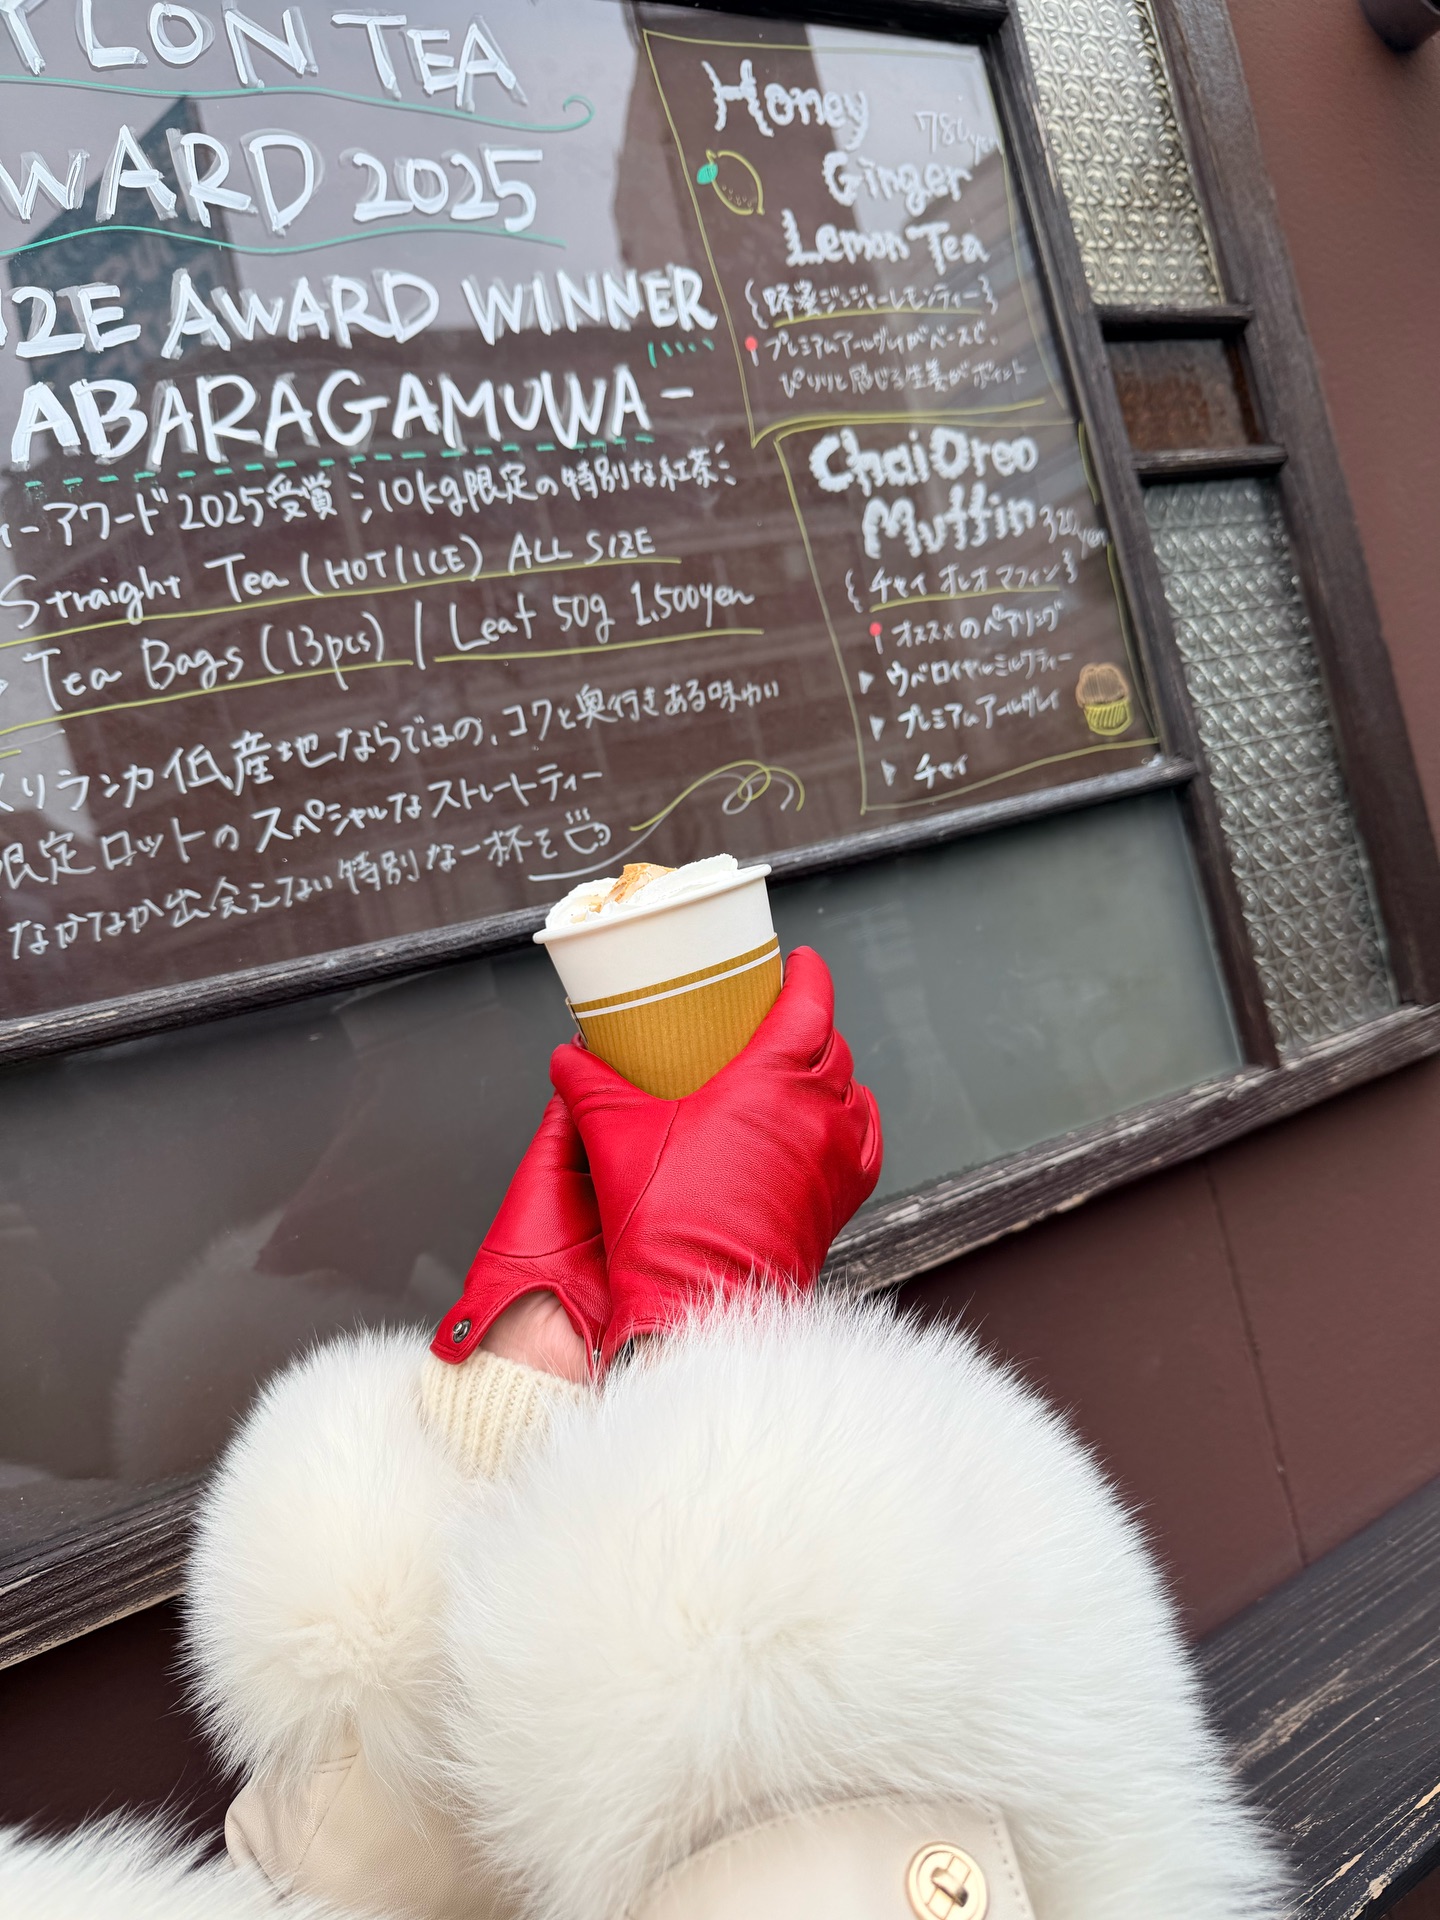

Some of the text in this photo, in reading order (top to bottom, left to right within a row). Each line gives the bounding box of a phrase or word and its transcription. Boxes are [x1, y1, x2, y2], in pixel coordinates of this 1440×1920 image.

[332, 13, 527, 112] TEA
[702, 59, 869, 150] Honey
[0, 125, 544, 236] WARD 2025
[822, 151, 973, 216] Ginger
[782, 208, 990, 275] Lemon Tea
[161, 268, 440, 360] AWARD
[461, 263, 718, 346] WINNER
[11, 364, 652, 471] ABARAGAMUWA
[809, 427, 1038, 497] Chai Oreo
[862, 482, 1036, 560] Muffin
[0, 567, 181, 630] Straight
[204, 553, 289, 602] Tea
[507, 533, 572, 574] ALL
[584, 527, 656, 566] SIZE
[22, 647, 123, 712] Tea
[140, 636, 245, 690] Bags
[259, 611, 385, 691] (13pcs)
[552, 594, 616, 644] 50g
